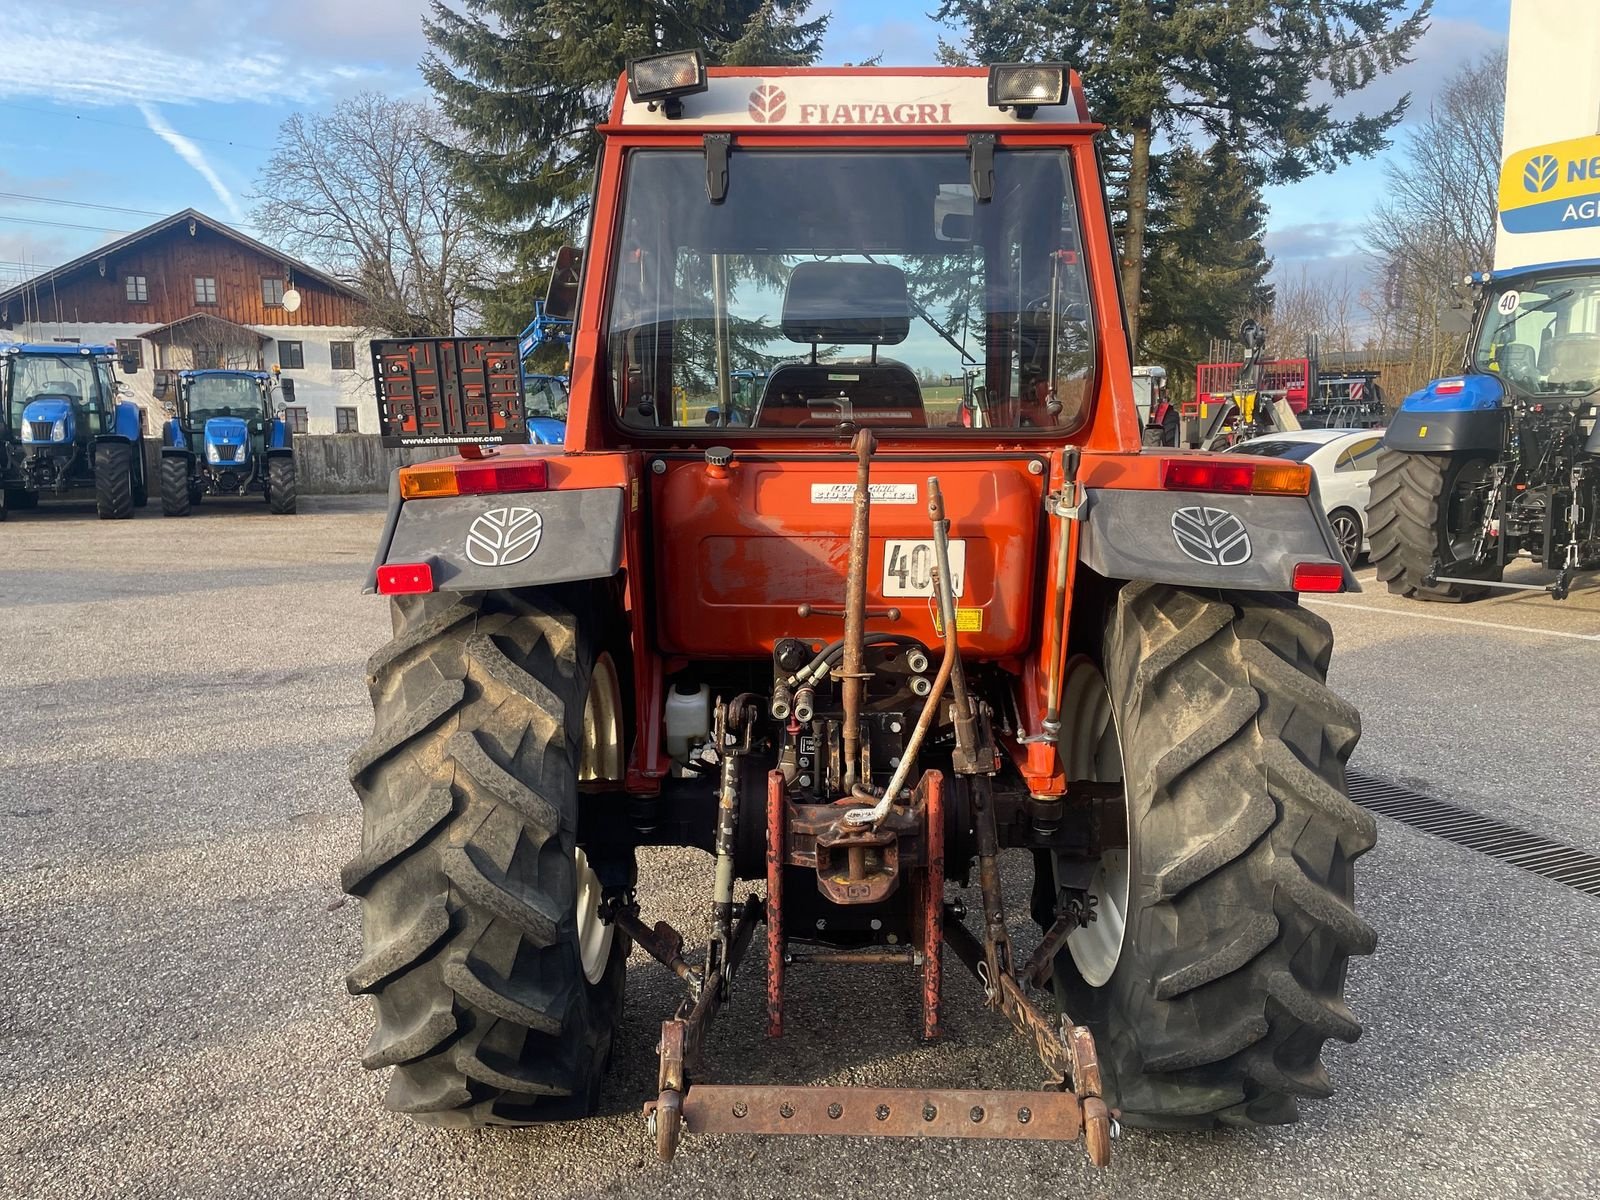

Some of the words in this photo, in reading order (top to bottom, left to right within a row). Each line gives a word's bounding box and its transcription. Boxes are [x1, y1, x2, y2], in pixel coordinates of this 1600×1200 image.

[799, 103, 952, 124] FIATAGRI
[1561, 200, 1600, 222] AG
[1500, 294, 1516, 310] 40
[888, 544, 931, 590] 40
